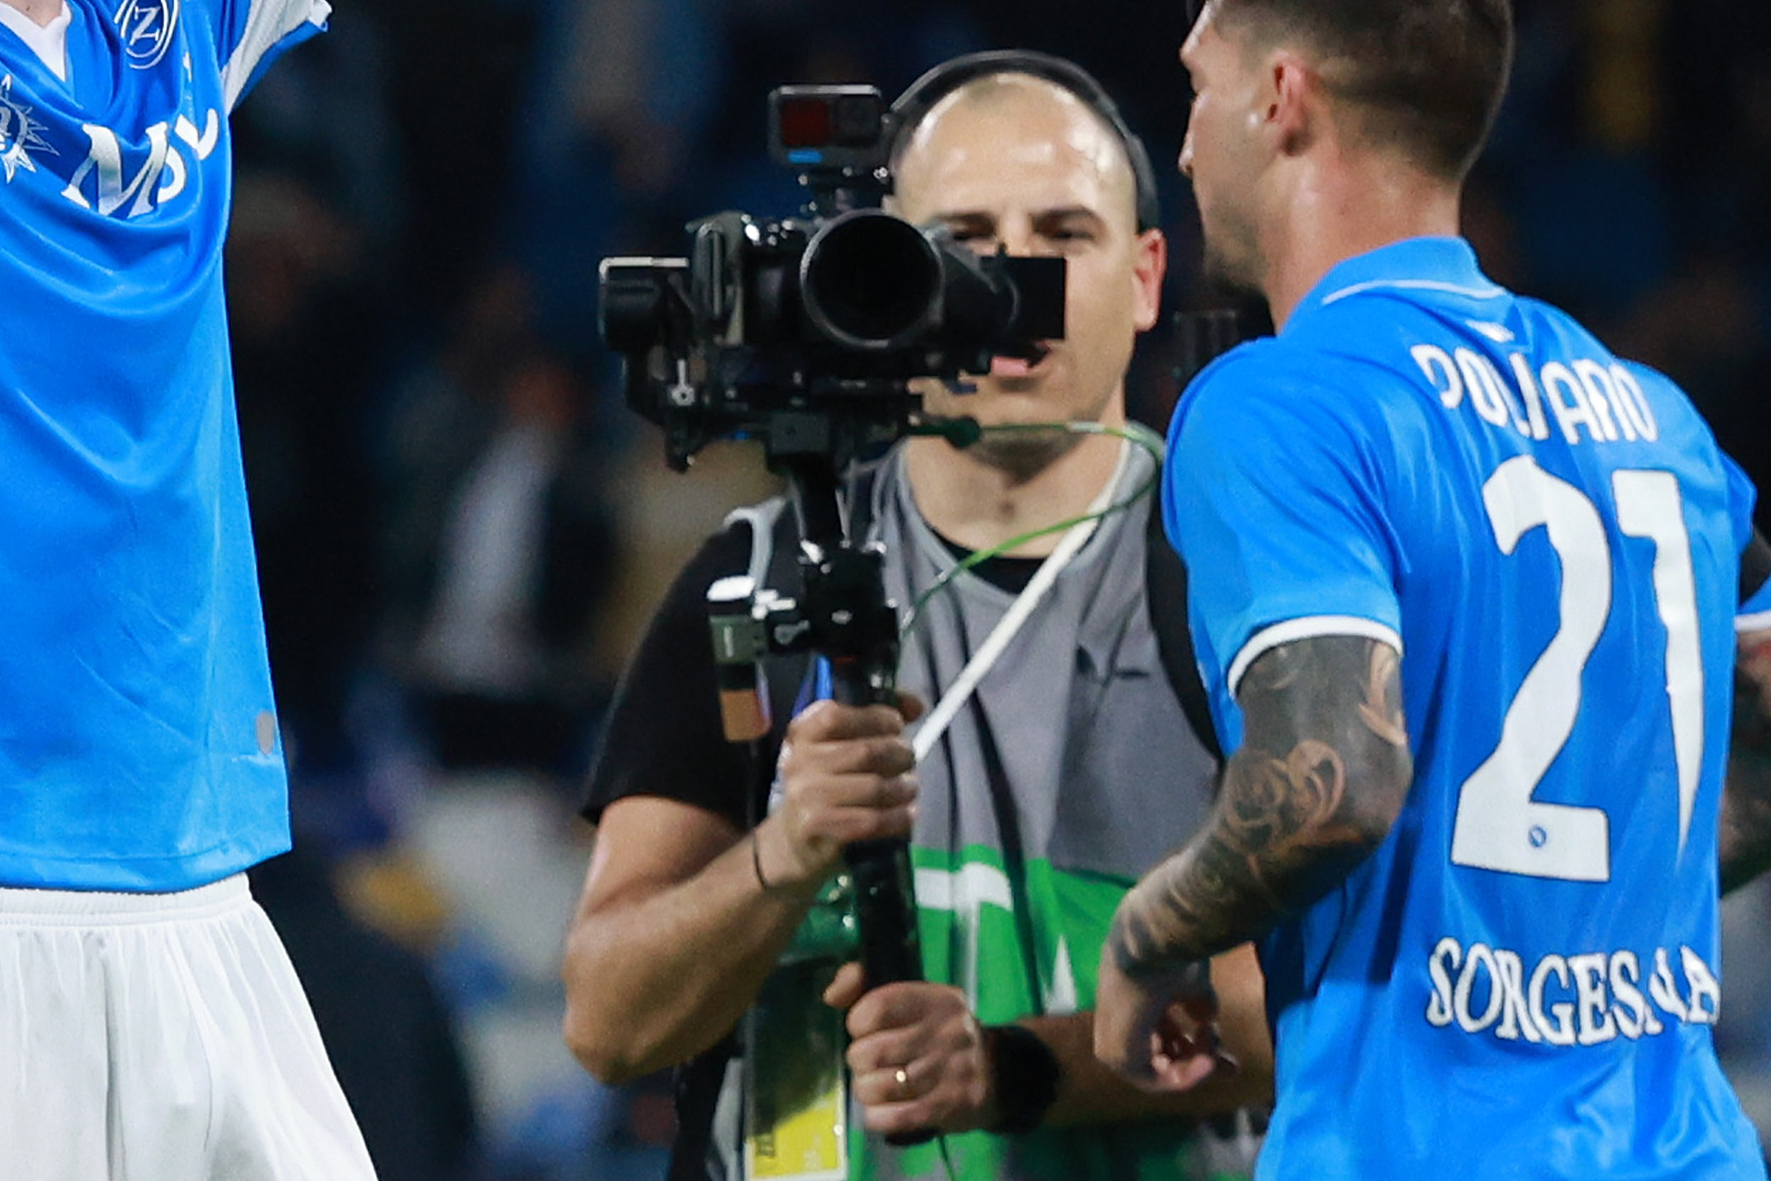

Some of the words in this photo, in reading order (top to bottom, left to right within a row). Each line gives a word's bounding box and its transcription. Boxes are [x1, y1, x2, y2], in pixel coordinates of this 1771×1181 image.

[1410, 343, 1659, 446] POLIANO
[1451, 454, 1704, 883] 21
[1427, 937, 1721, 1046] SORGESNA
